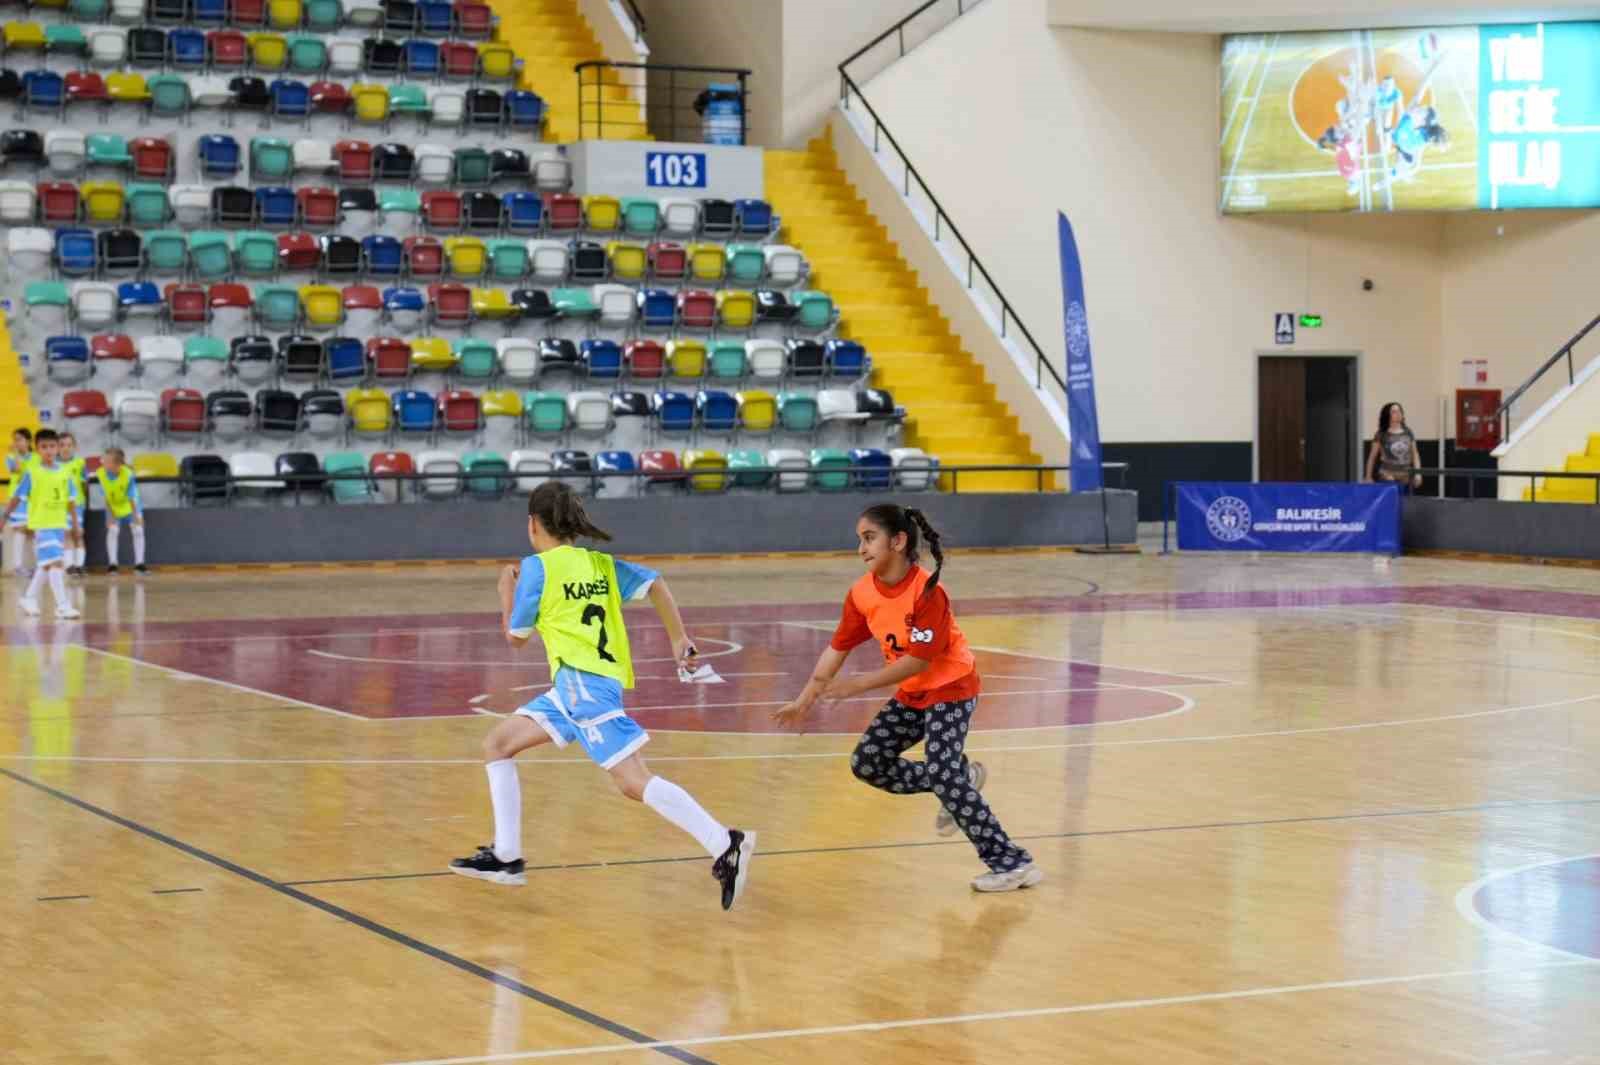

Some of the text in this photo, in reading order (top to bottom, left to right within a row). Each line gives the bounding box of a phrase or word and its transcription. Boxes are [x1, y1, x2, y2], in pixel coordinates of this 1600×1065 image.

[650, 154, 699, 186] 103
[1276, 507, 1342, 520] BALIKESİR
[581, 603, 616, 663] 2
